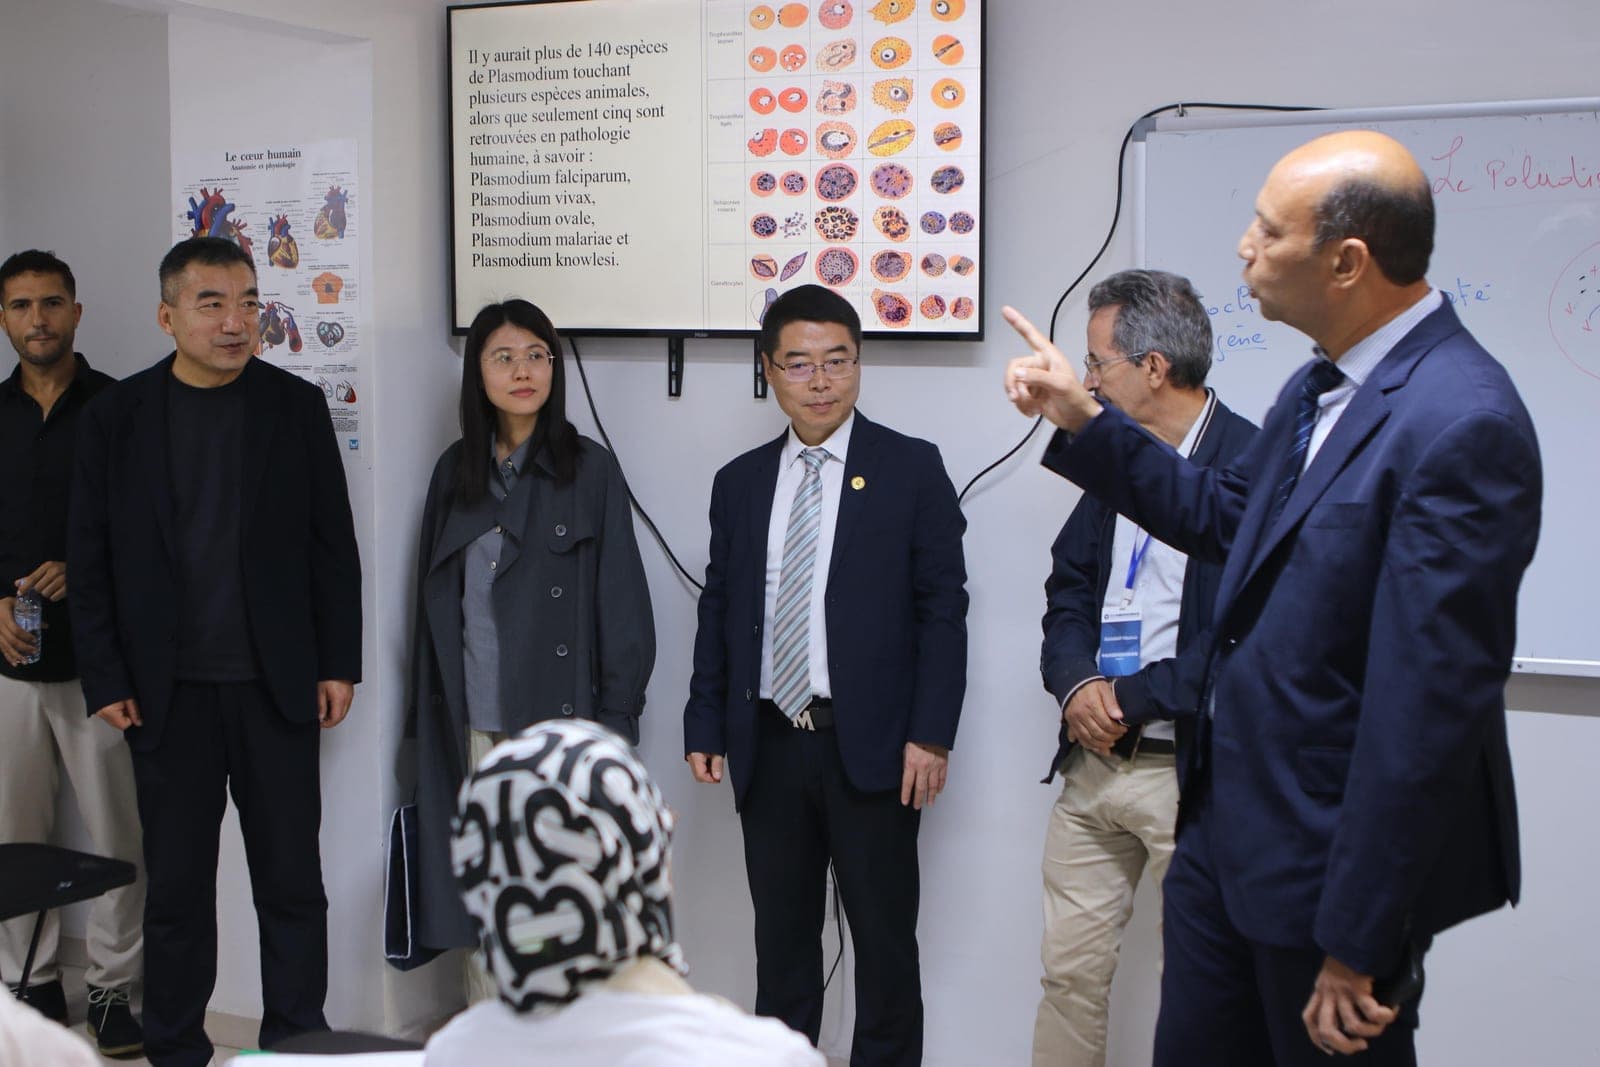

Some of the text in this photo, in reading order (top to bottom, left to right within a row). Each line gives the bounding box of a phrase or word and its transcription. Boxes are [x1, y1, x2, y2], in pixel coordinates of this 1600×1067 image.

[468, 40, 668, 67] Il y aurait plus de 140 espèces
[468, 64, 631, 84] de Plasmodium touchant
[469, 83, 650, 108] plusieurs espèces animales,
[469, 104, 665, 128] alors que seulement cinq sont
[469, 125, 631, 146] retrouvées en pathologie
[225, 148, 301, 162] Le cœur humain
[470, 148, 593, 166] humaine, à savoir :
[471, 169, 631, 187] Plasmodium falciparum,
[471, 190, 596, 207] Plasmodium vivax,
[471, 210, 595, 227] Plasmodium ovale,
[472, 231, 629, 247] Plasmodium malariae et
[472, 251, 619, 268] Plasmodium knowlesi.
